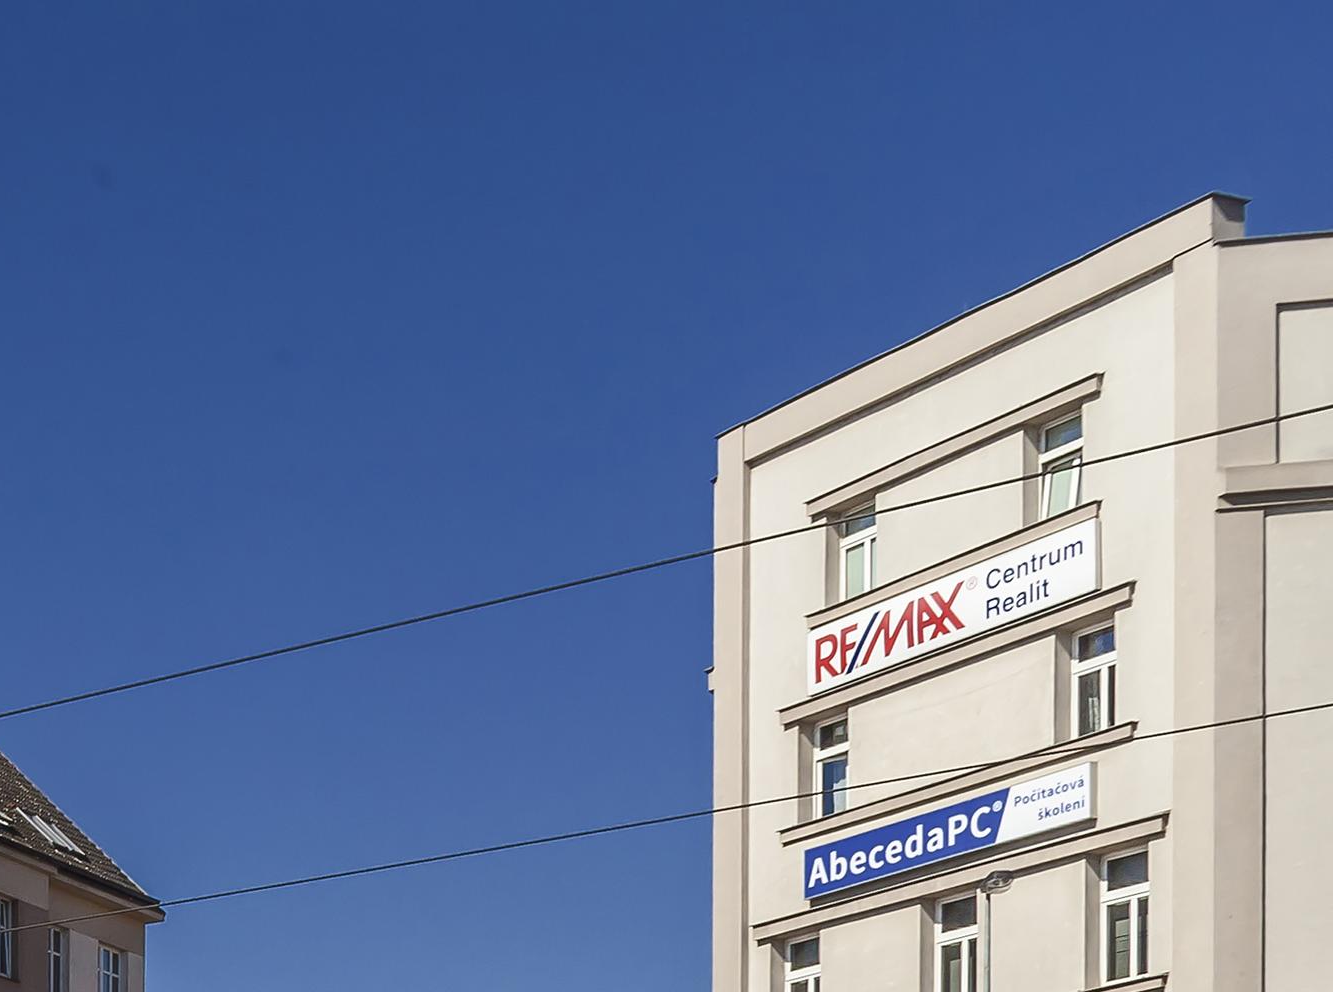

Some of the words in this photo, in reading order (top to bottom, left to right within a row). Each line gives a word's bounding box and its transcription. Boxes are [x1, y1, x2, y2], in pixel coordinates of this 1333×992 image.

[986, 539, 1083, 590] Centrum
[986, 579, 1049, 619] Realit
[815, 580, 966, 684] RE/MAX
[1014, 775, 1085, 808] Počítačová
[1038, 796, 1085, 821] školení
[807, 805, 992, 889] AbecedaPC
